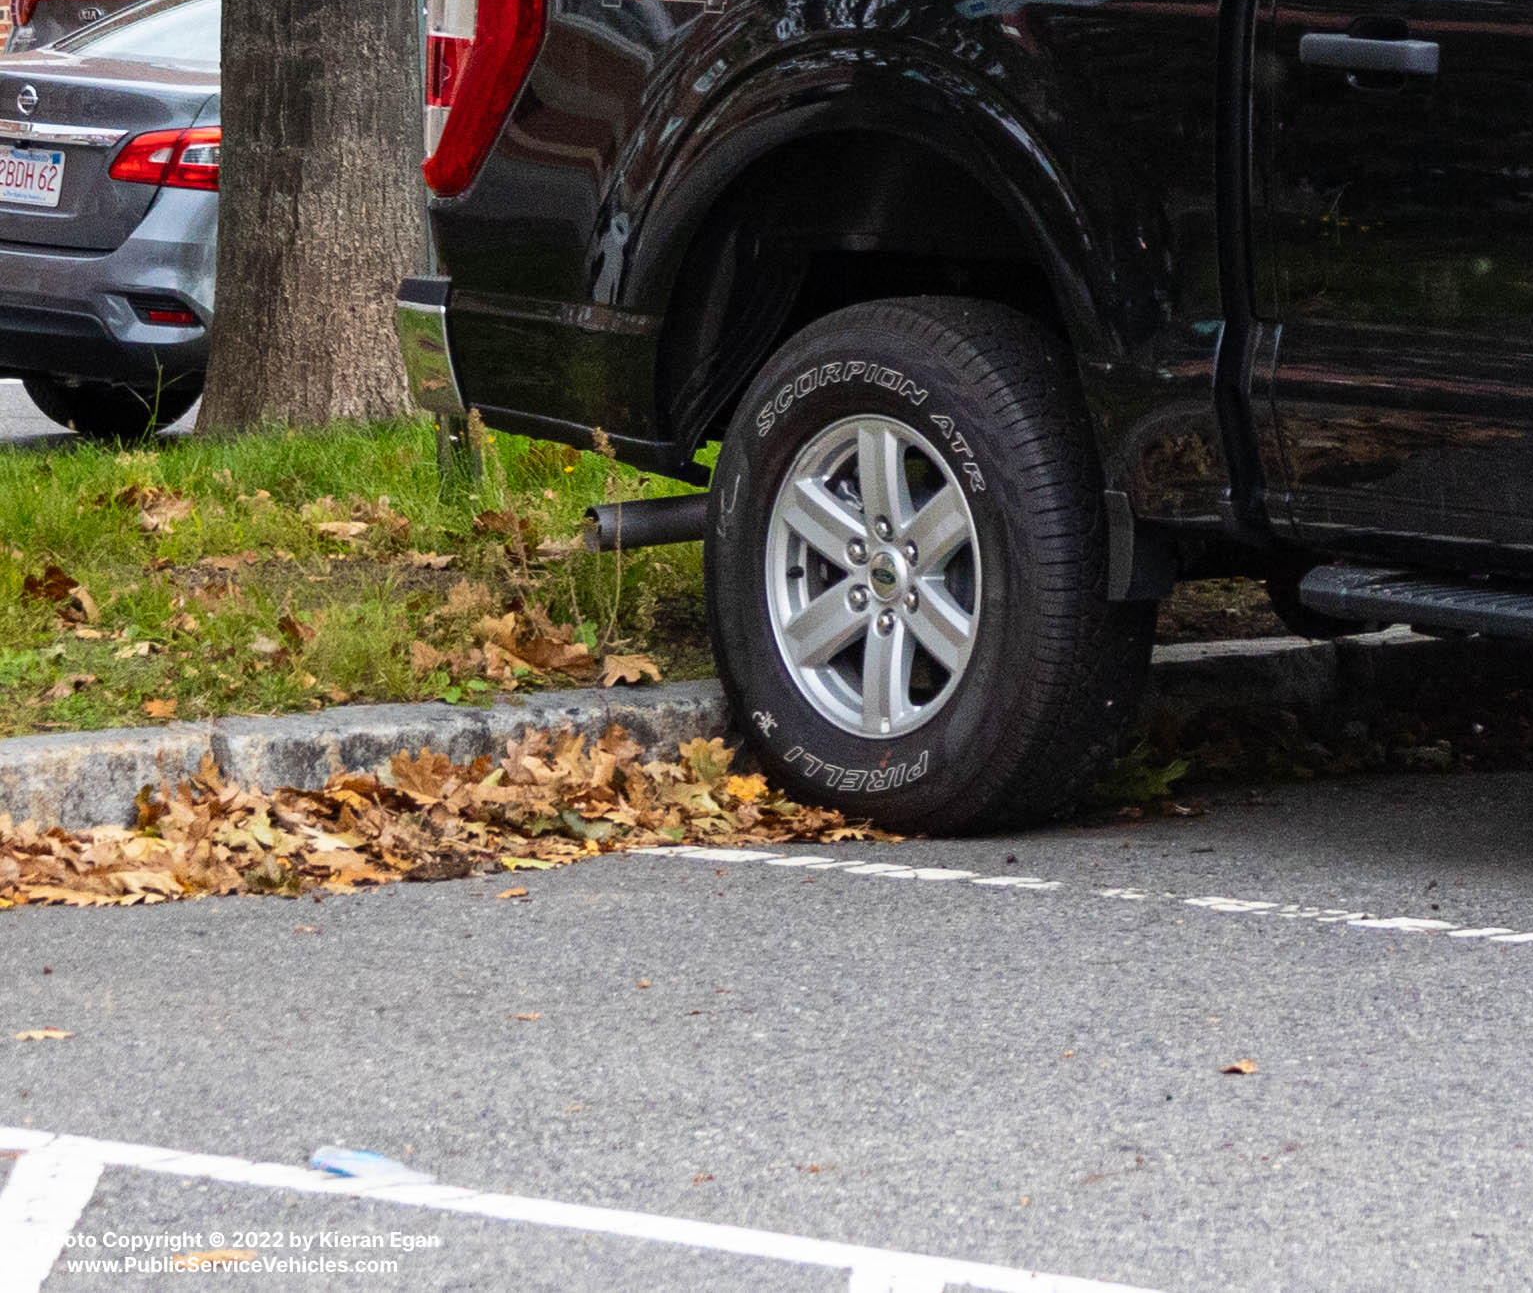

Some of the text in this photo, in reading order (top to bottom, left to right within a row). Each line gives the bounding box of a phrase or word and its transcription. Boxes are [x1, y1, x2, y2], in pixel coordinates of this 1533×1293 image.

[38, 165, 58, 192] 62
[756, 361, 986, 493] SCORPION ATR
[784, 746, 929, 792] PIRELLI
